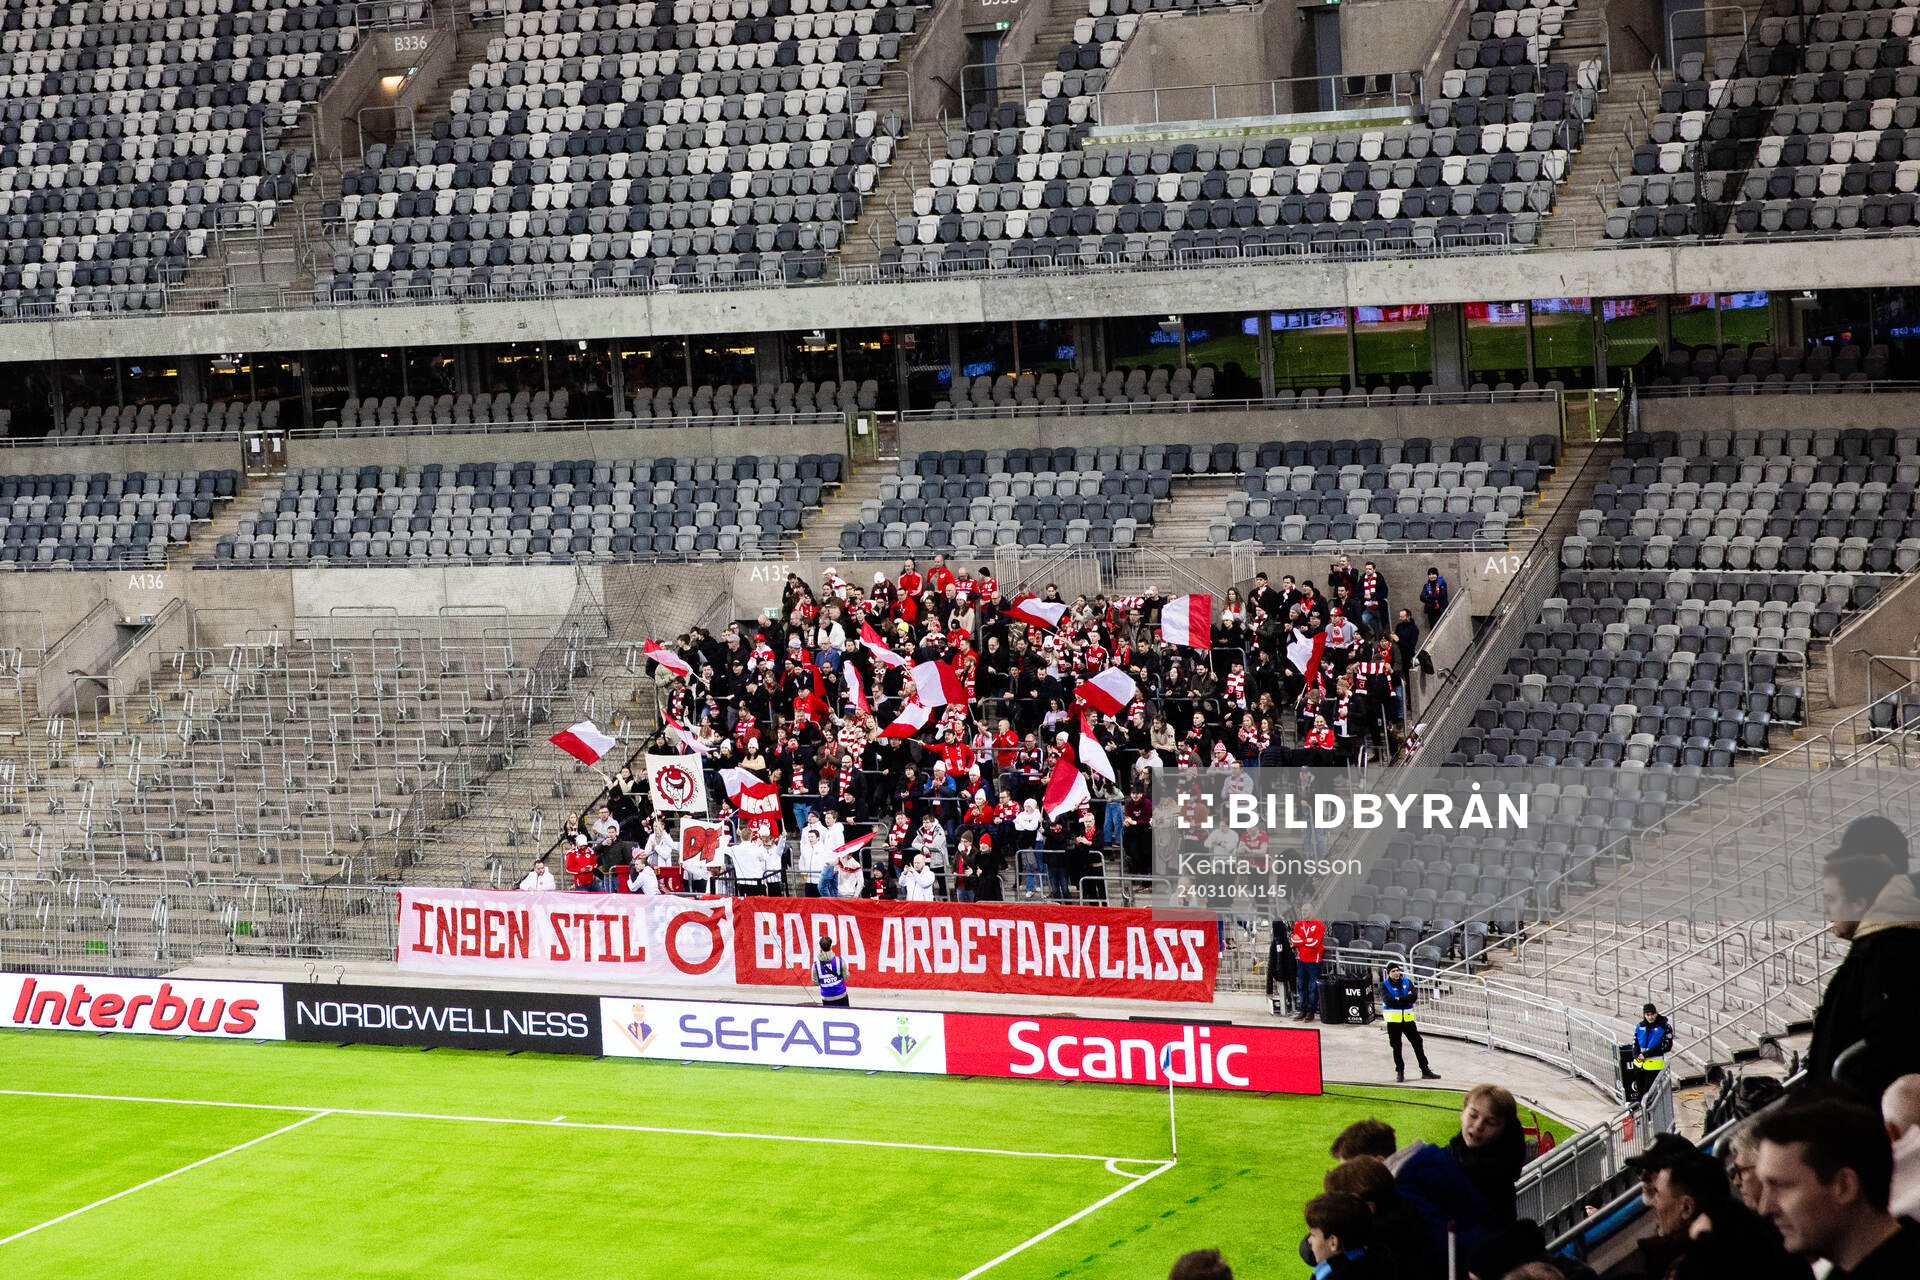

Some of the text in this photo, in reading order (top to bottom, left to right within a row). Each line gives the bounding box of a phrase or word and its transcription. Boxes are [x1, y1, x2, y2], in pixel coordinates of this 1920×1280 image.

[394, 36, 428, 51] B336
[128, 574, 164, 590] A136
[750, 564, 789, 582] A135
[550, 912, 646, 963] STIL
[878, 915, 1206, 981] ARBETARKLASS
[12, 977, 260, 1034] Interbus
[296, 1001, 588, 1038] NORDICWELLNESS
[679, 1014, 862, 1056] SEFAB
[1007, 1020, 1250, 1086] Scandic
